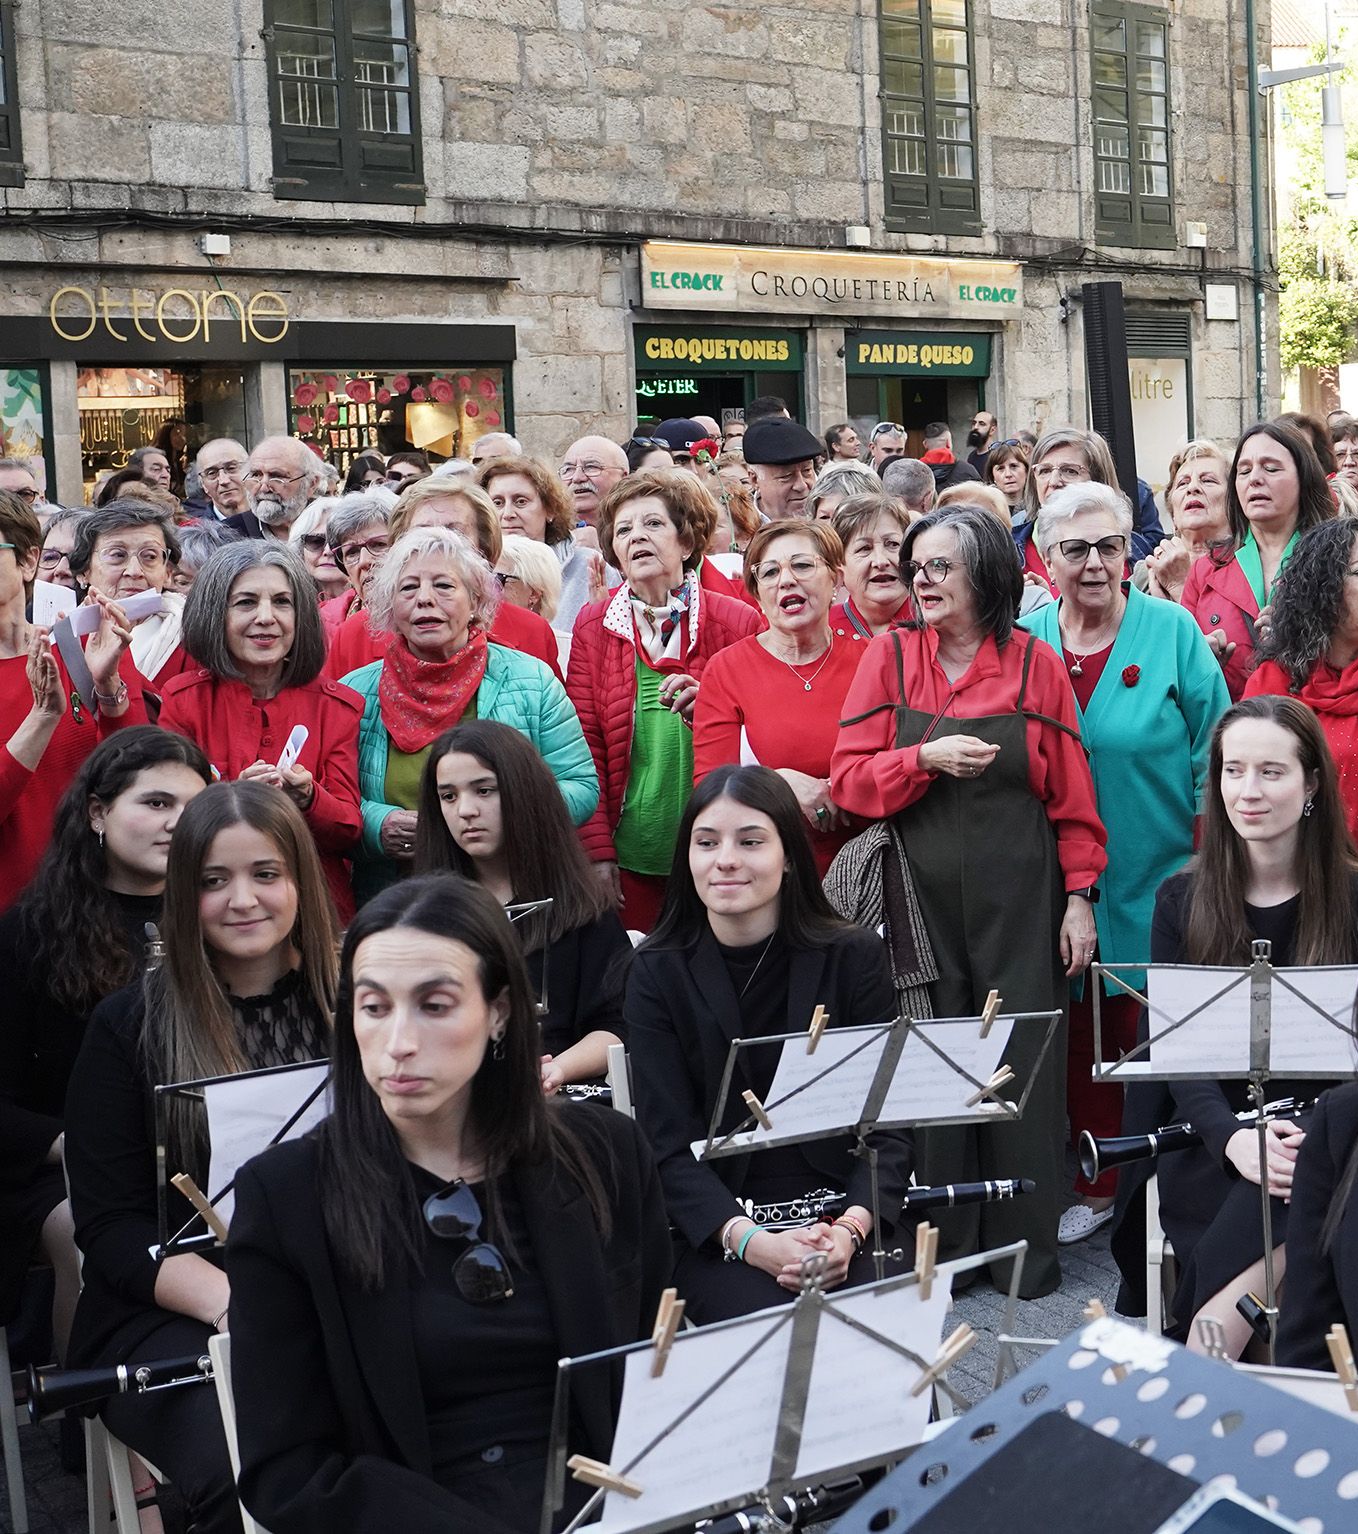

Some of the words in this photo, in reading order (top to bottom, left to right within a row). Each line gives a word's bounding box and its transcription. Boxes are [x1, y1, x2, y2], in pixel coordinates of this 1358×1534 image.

[651, 271, 670, 290] EL
[671, 271, 724, 291] CRACK
[751, 270, 936, 304] CROQUETERÍA
[959, 285, 974, 301] EL
[975, 285, 1017, 304] CRACK
[50, 287, 288, 343] ottone
[646, 337, 789, 364] CROQUETONES
[858, 344, 895, 364] PAN
[896, 345, 918, 364] DE
[920, 345, 973, 368] QUESO
